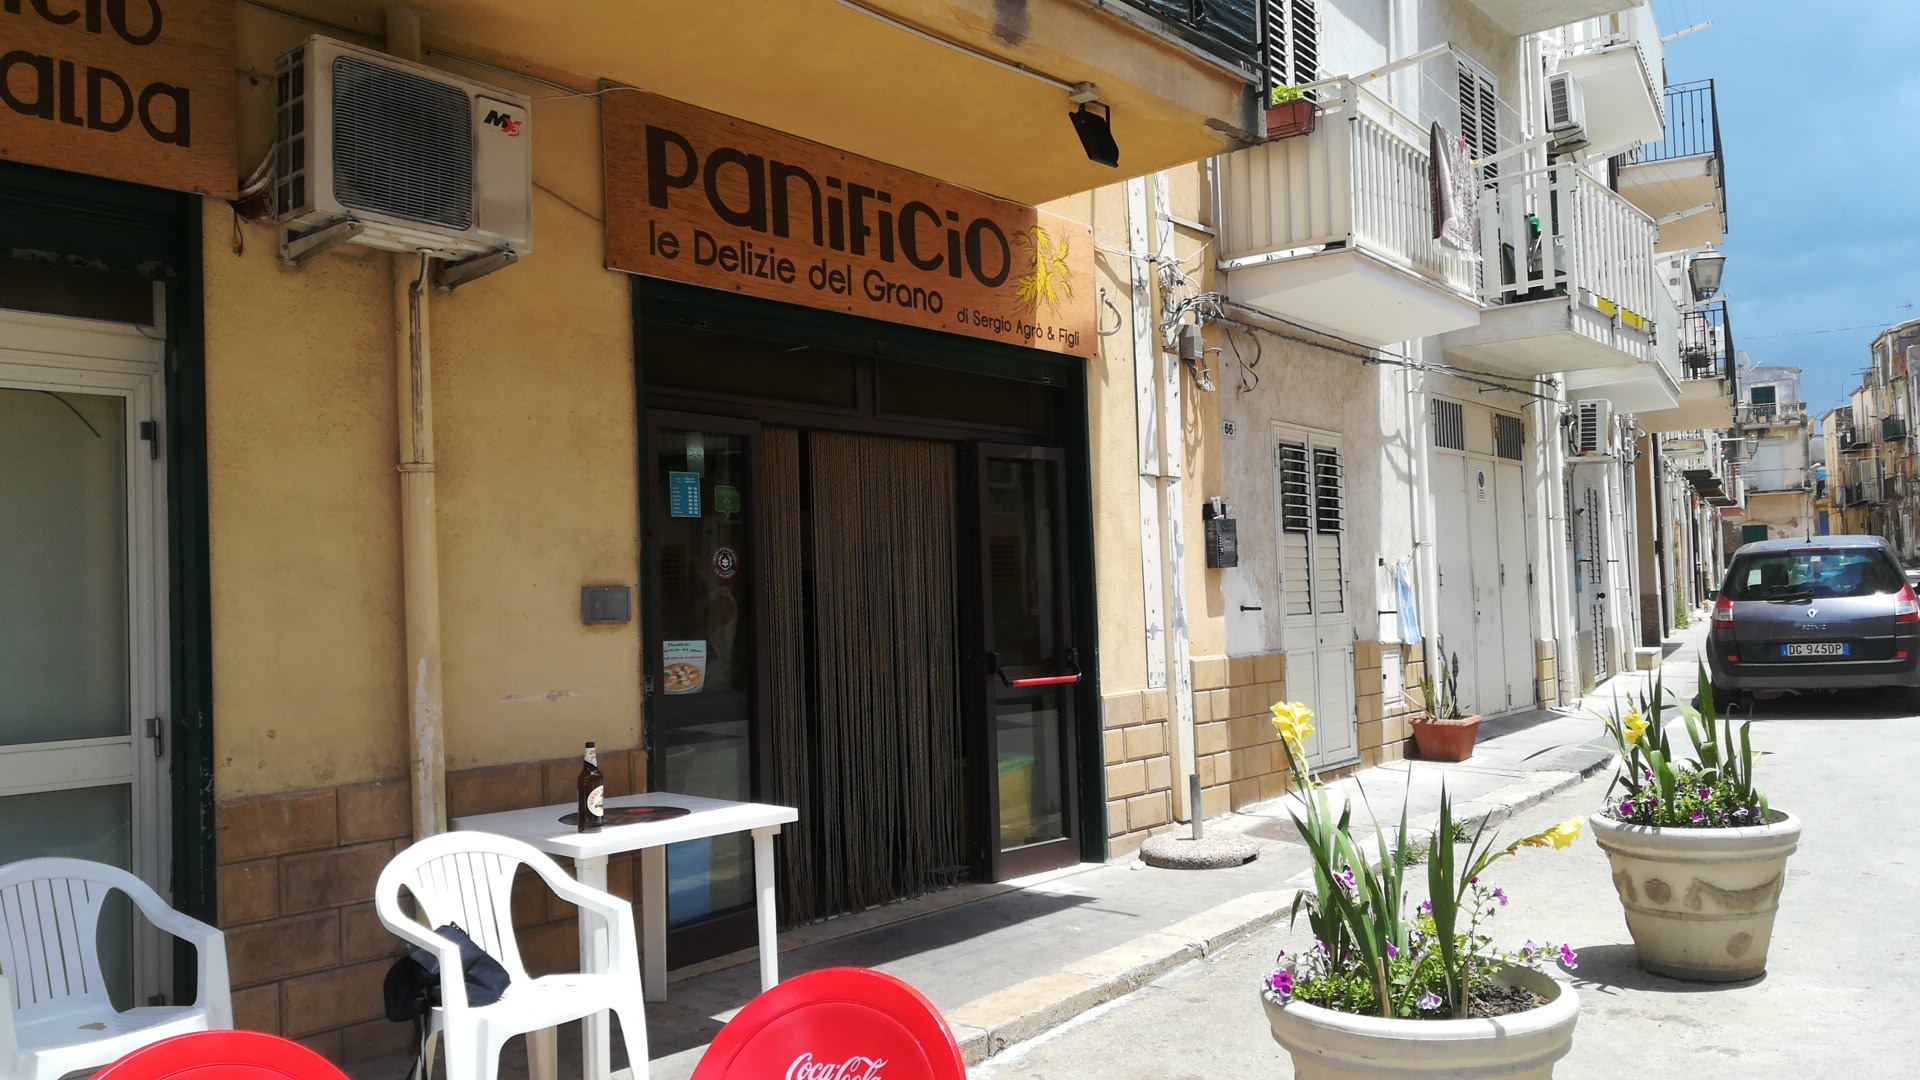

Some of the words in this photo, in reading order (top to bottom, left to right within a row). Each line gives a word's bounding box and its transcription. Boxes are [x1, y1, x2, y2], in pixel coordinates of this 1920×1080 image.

[649, 219, 680, 259] le
[694, 229, 796, 284] Delizie
[808, 258, 852, 296] del
[863, 269, 943, 314] Grano
[957, 308, 969, 324] di
[973, 310, 1012, 334] Sergio
[1016, 320, 1043, 340] Agrò
[1047, 326, 1055, 341] &
[1059, 328, 1080, 348] Figli
[1224, 422, 1234, 435] 66
[1789, 644, 1802, 655] DG
[1806, 644, 1842, 655] 945DP
